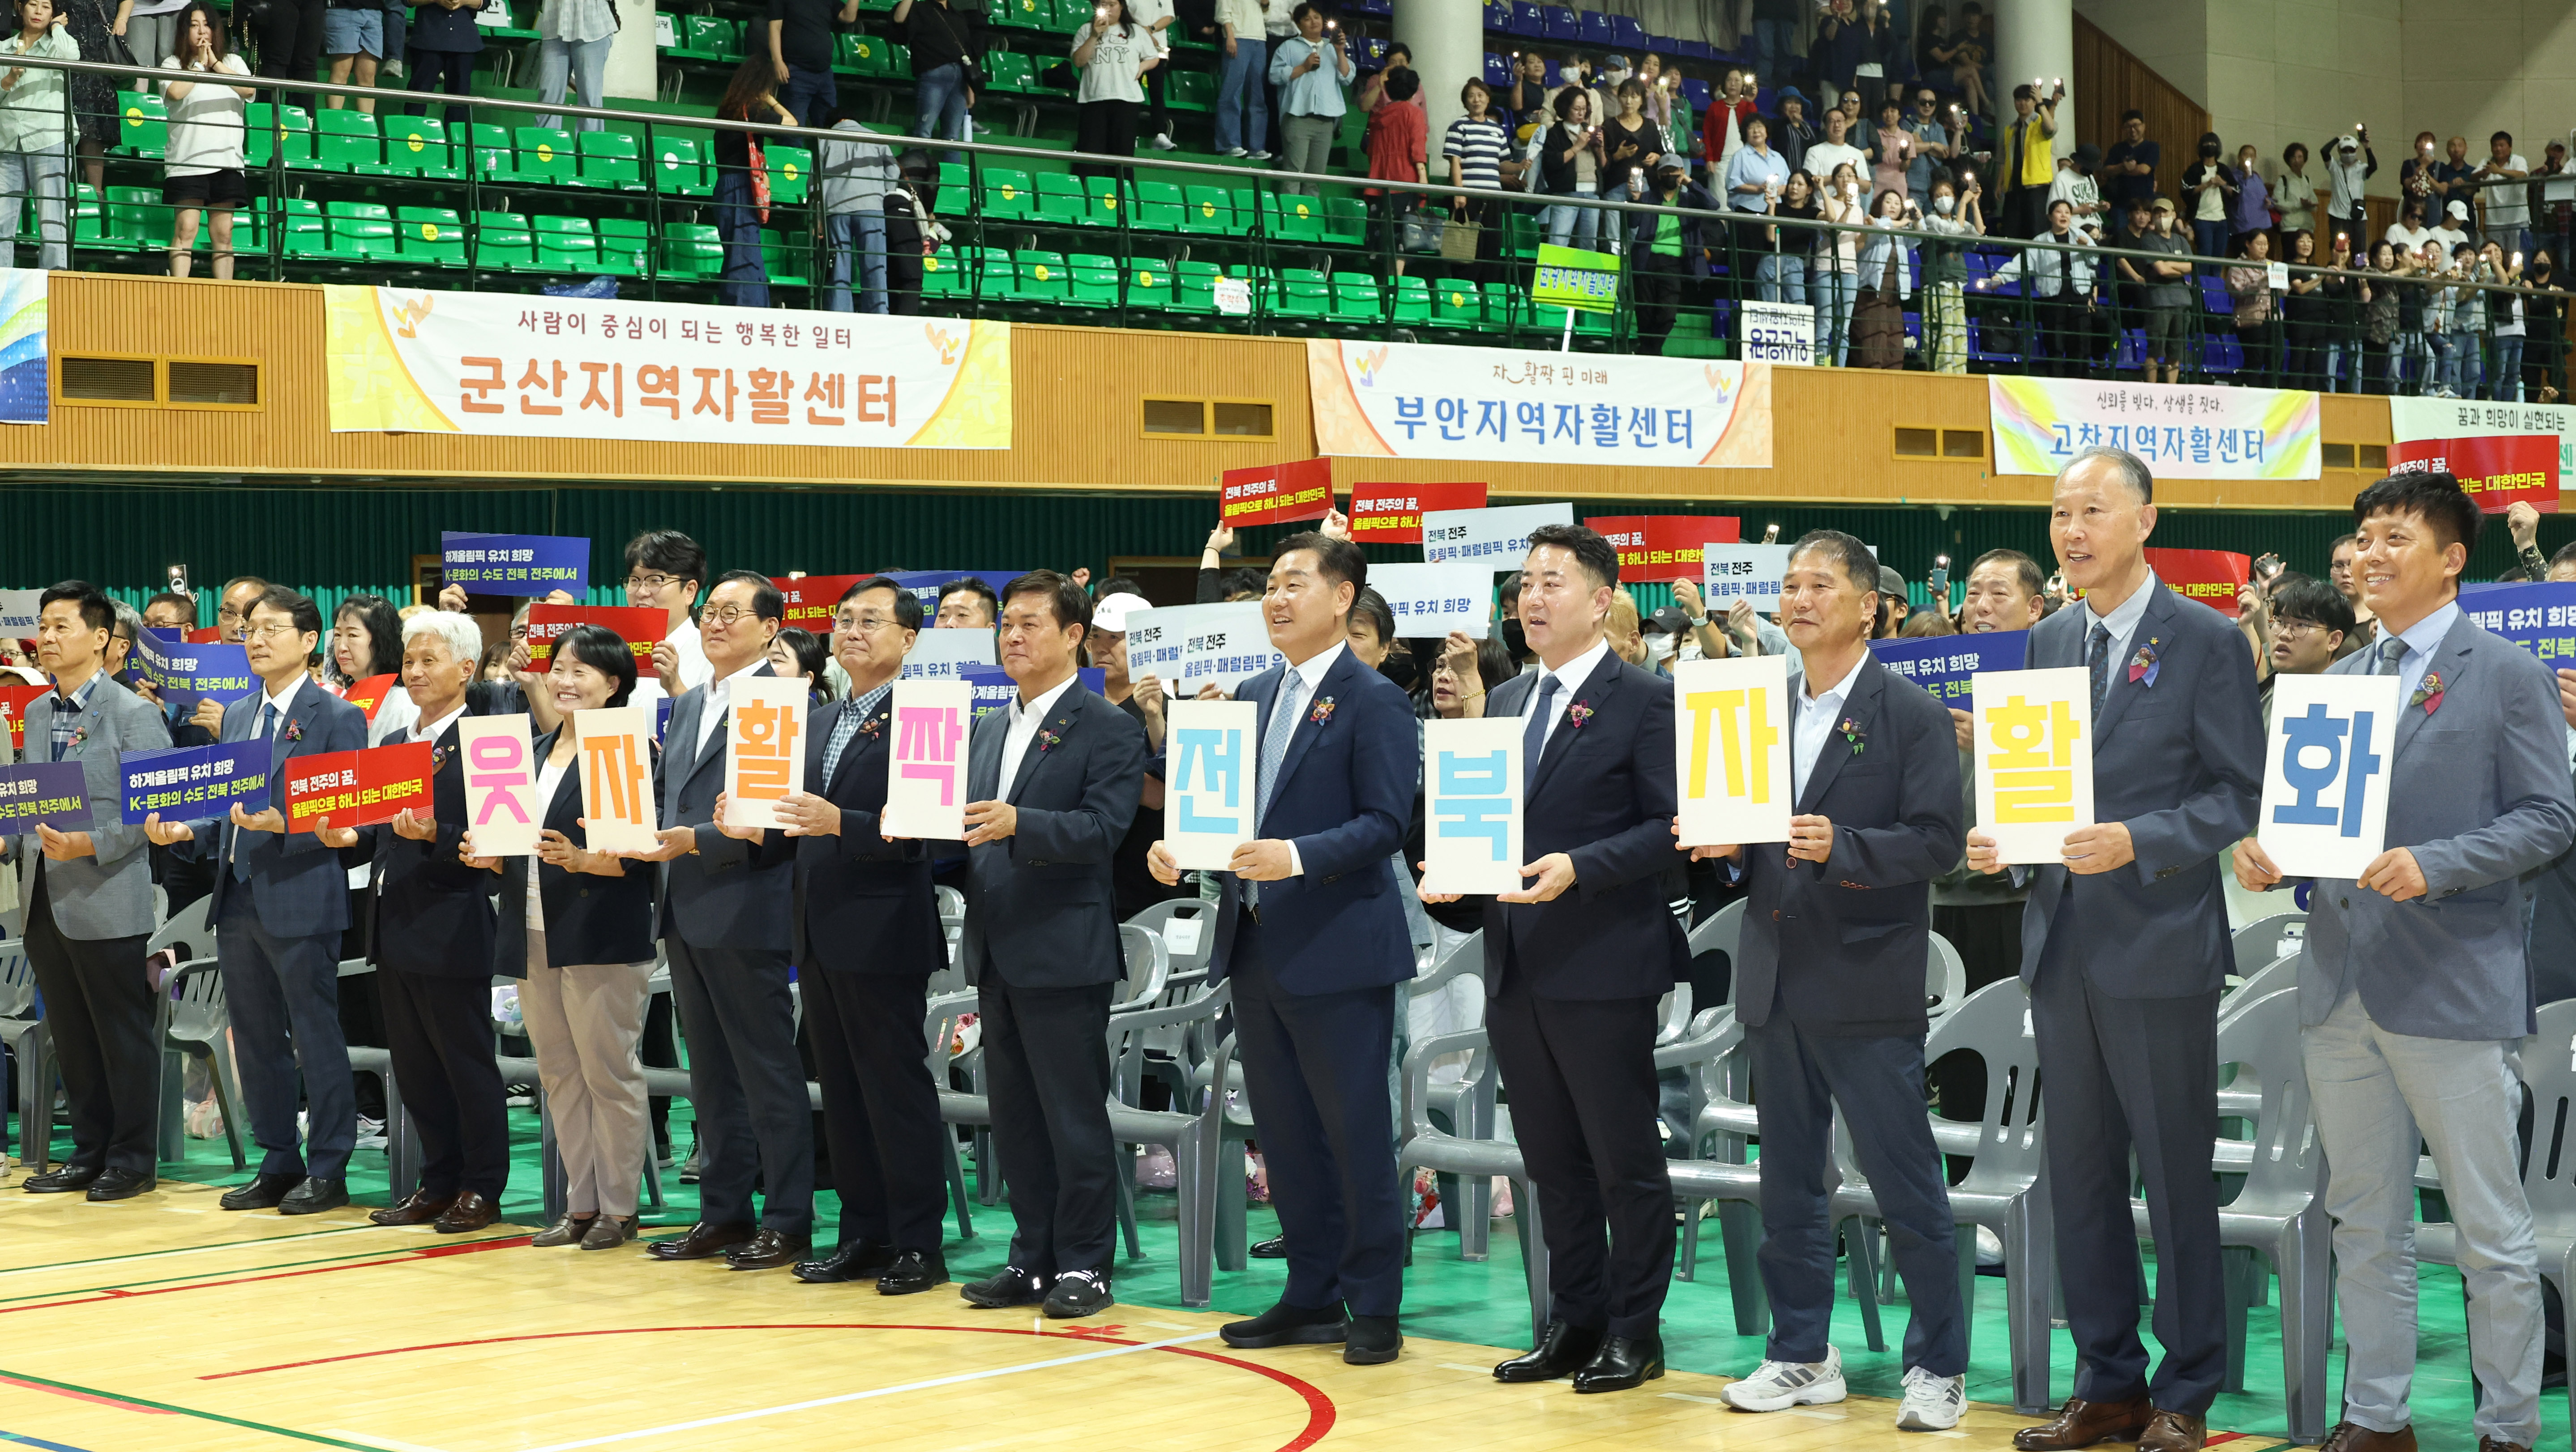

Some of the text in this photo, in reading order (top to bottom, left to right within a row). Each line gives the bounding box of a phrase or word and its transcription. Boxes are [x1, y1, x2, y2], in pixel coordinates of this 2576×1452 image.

[1094, 46, 1129, 64] NY
[518, 310, 852, 349] 사람이 중심이 되는 행복한 일터
[1562, 367, 1574, 386] 핀
[1582, 370, 1608, 385] 미래
[460, 356, 896, 427] 군산지역자활센터
[2097, 390, 2224, 414] 신뢰를 빚다, 상생을 짓다.
[1394, 396, 1693, 448] 부안지역자활센터
[2458, 407, 2565, 431] 꿈과 희망이 실현되는
[2432, 457, 2450, 473] 꿈,
[1226, 479, 1277, 500] 전북 전주의 꿈,
[2486, 472, 2546, 491] 대한민국
[1224, 487, 1326, 517] 올림픽으로 하나 되는 대한민국
[1355, 497, 1419, 512] 전북 전주의 꿈,
[1353, 516, 1398, 530] 올림픽으로
[1400, 515, 1419, 528] 하나
[1428, 526, 1467, 542] 전북 전주
[1631, 531, 1645, 546] 꿈,
[445, 548, 534, 563] 하계올림픽 유치 희망
[1428, 538, 1529, 561] 올림픽·패럴림픽 유치
[1627, 551, 1648, 566] 하나
[1650, 550, 1672, 564] 되는
[445, 567, 577, 581] K-문화의 수도 전북 전주에서
[1710, 561, 1753, 576] 전북 전주
[791, 591, 803, 603] 꿈,
[2186, 582, 2235, 597] 대한민국
[787, 607, 805, 620] 하나
[807, 606, 827, 619] 되는
[1414, 599, 1438, 615] 유치
[1443, 598, 1471, 613] 희망
[0, 616, 34, 627] ·패럴림픽
[2508, 607, 2542, 631] 유치
[529, 624, 545, 638] 전북
[1129, 626, 1162, 646] 전북 전주
[1187, 633, 1226, 653] 전북 전주
[2537, 636, 2576, 659] 전북
[155, 653, 168, 670] 유치
[171, 658, 198, 672] 희망
[1131, 645, 1182, 668] 올림픽·패럴
[1185, 653, 1266, 678] 올림픽·패럴림픽
[1919, 657, 1946, 676] 유치
[1948, 652, 1980, 672] 희망
[928, 662, 950, 676] 유치
[153, 672, 165, 687] 수도
[167, 676, 191, 691] 전북
[195, 676, 248, 692] 전주에서
[1944, 679, 1973, 698] 전북
[735, 699, 798, 800] 활
[896, 706, 963, 806] 짝
[1686, 687, 1778, 804] 자
[1986, 695, 2080, 824] 활
[2272, 703, 2380, 837] 화
[129, 758, 235, 789] 하계올림픽 유치 희망
[290, 769, 358, 797] 전북 전주의 꿈,
[470, 735, 531, 825] 웃
[583, 734, 644, 824] 자
[1174, 729, 1241, 834] 전
[19, 779, 37, 795] 희망
[129, 772, 265, 811] K-문화의 수도 전북 전주에서
[17, 800, 37, 817] 전북
[39, 795, 82, 815] 전주에서
[291, 777, 423, 820] 올림픽으로 하나 되는 대한민국
[1434, 750, 1512, 861] 북
